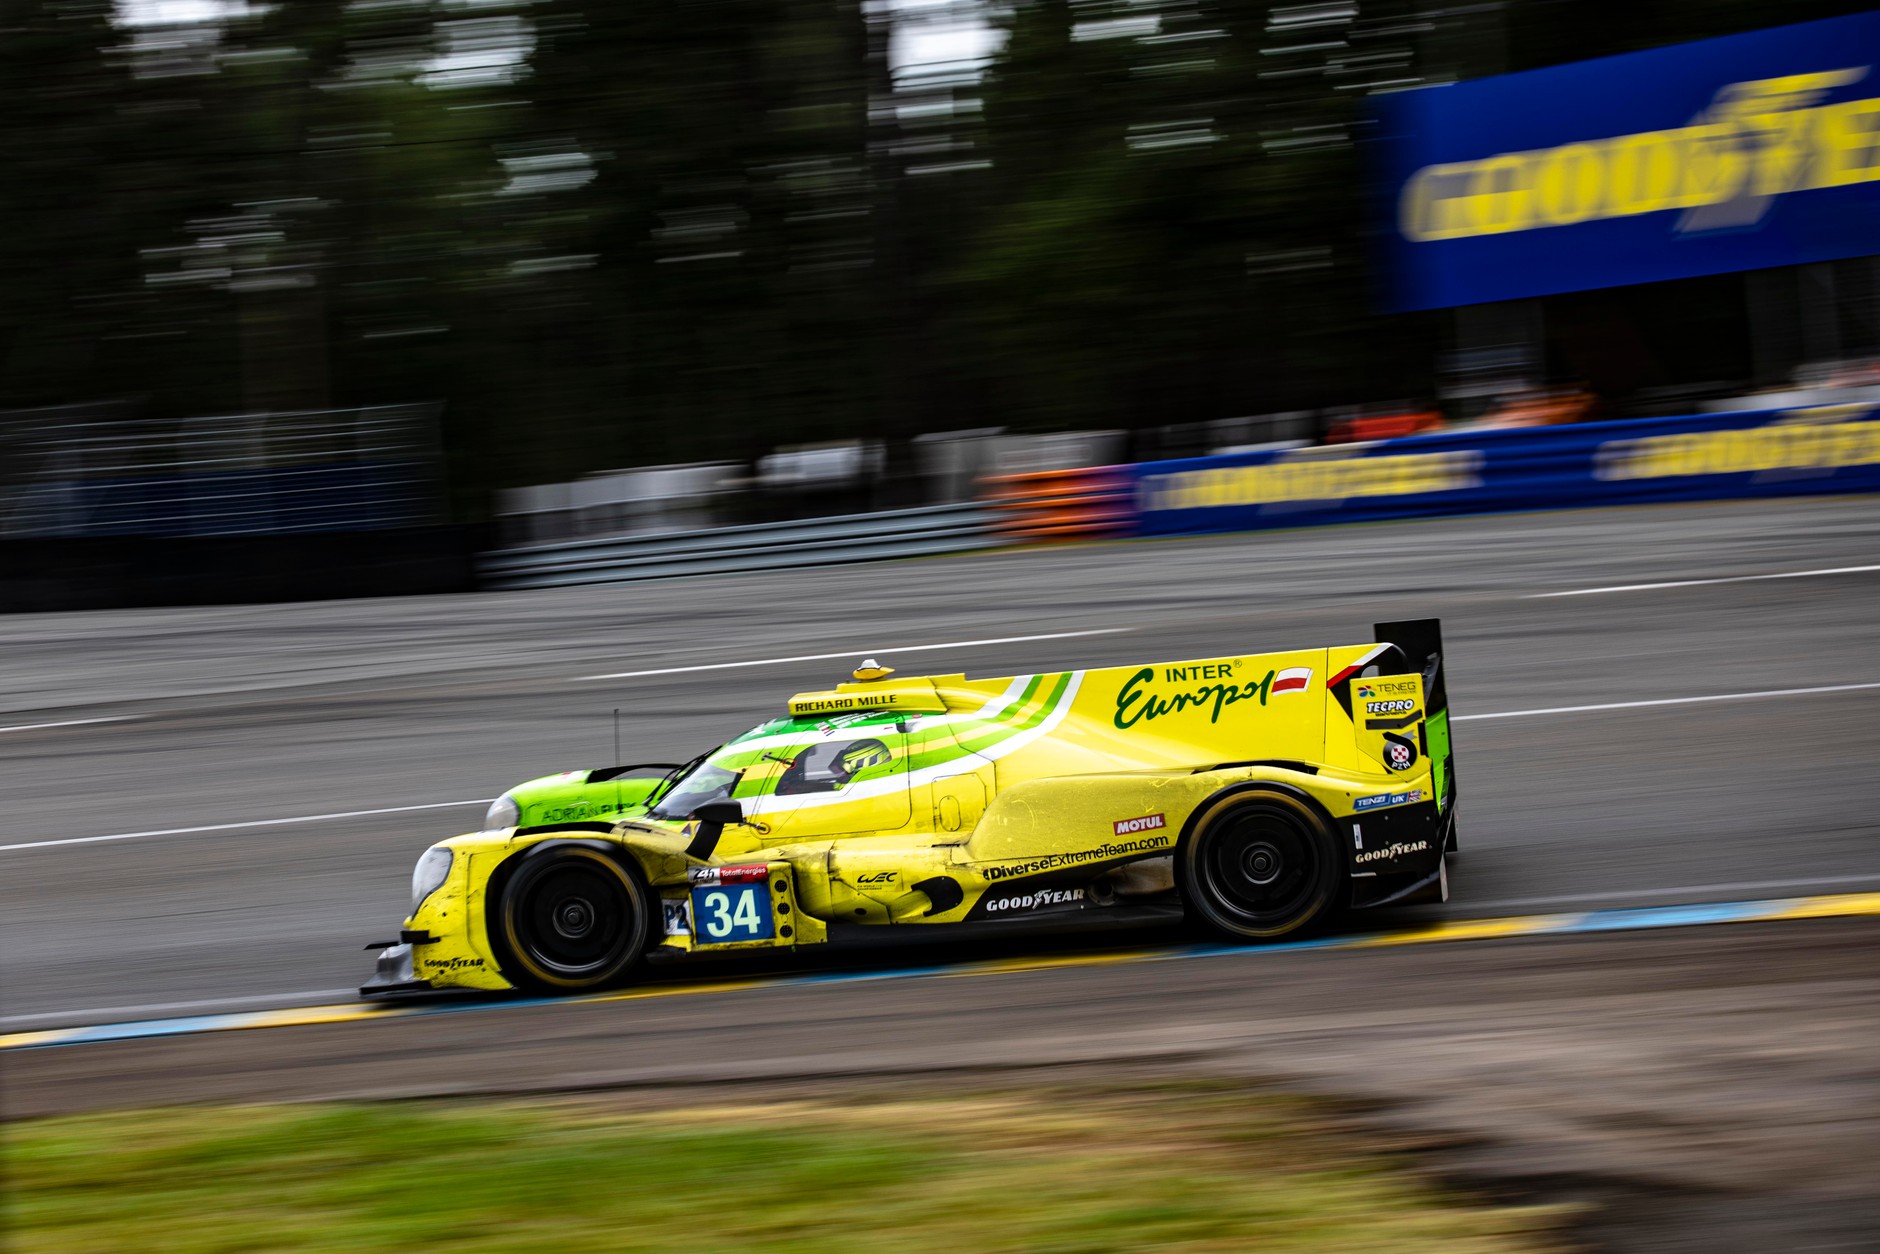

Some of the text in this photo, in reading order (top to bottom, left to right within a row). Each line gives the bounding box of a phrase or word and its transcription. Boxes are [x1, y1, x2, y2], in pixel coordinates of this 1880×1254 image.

[1377, 681, 1416, 693] TENEG
[795, 694, 897, 712] RICHARD MILLE
[1114, 667, 1275, 730] Europol
[1366, 699, 1414, 714] TECPRO
[1391, 795, 1405, 804] UK
[1117, 815, 1163, 834] MOTUL
[989, 834, 1169, 880] DiverseExtremeTeam.com
[1355, 840, 1428, 864] GOODYEAR
[857, 871, 898, 884] WEC
[985, 888, 1085, 912] GOODYEAR
[664, 903, 688, 931] P2
[704, 889, 761, 938] 34
[424, 957, 485, 969] GOODYEAR
